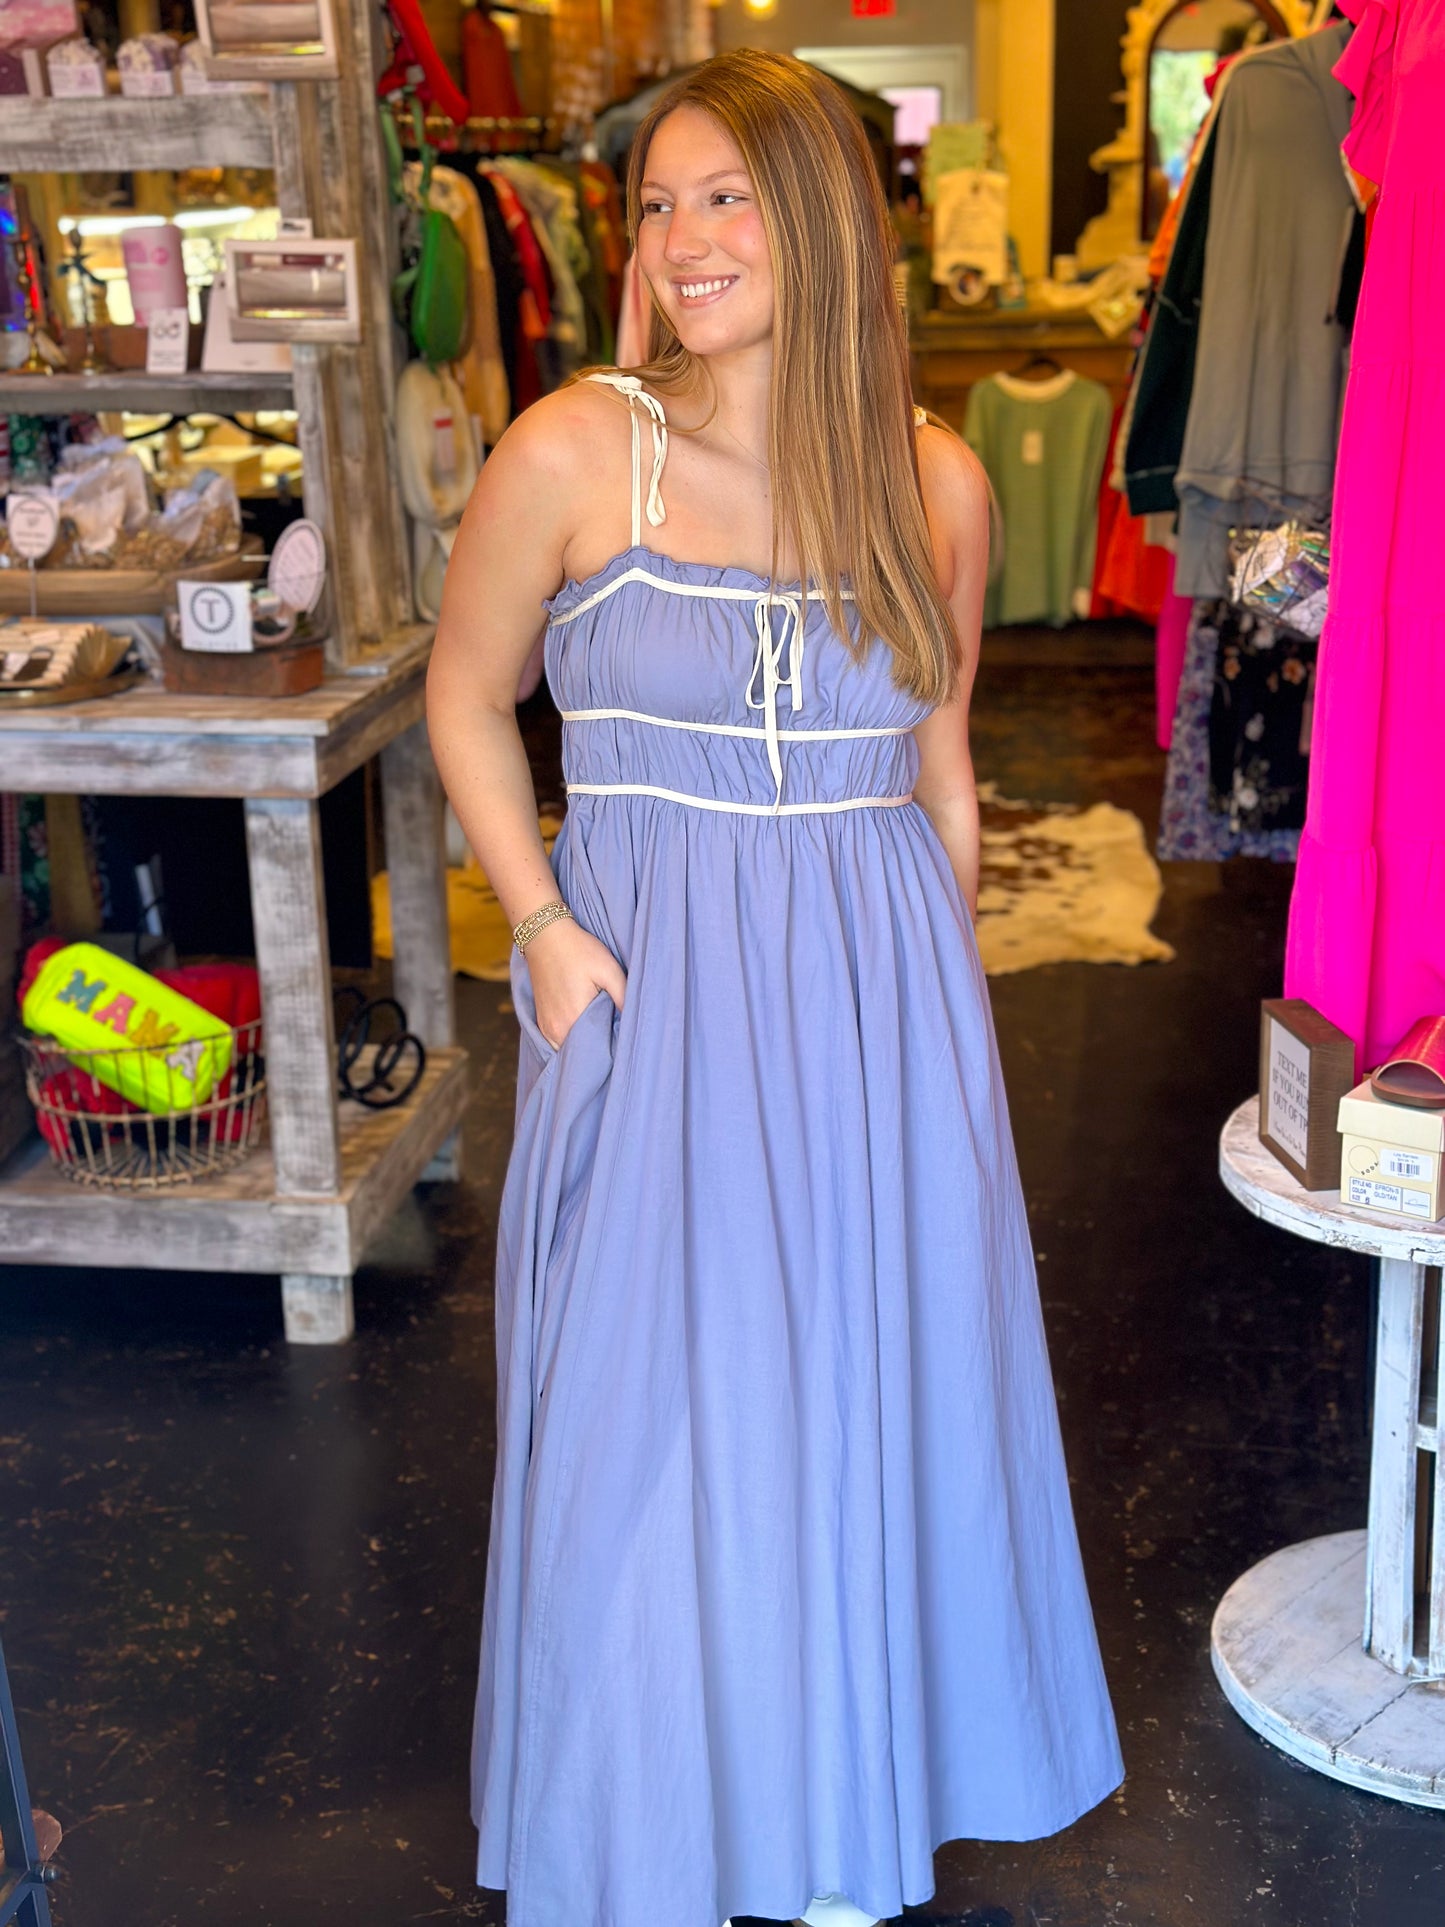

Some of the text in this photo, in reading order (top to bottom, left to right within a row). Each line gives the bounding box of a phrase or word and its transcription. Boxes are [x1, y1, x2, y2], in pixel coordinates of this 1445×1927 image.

[201, 599, 220, 623] T
[1272, 1067, 1279, 1083] IF
[1280, 1074, 1294, 1099] YOU
[1278, 1050, 1307, 1089] TEXT ME
[1273, 1090, 1288, 1114] OUT
[1288, 1104, 1298, 1123] OF
[1352, 1186, 1367, 1195] COLOR
